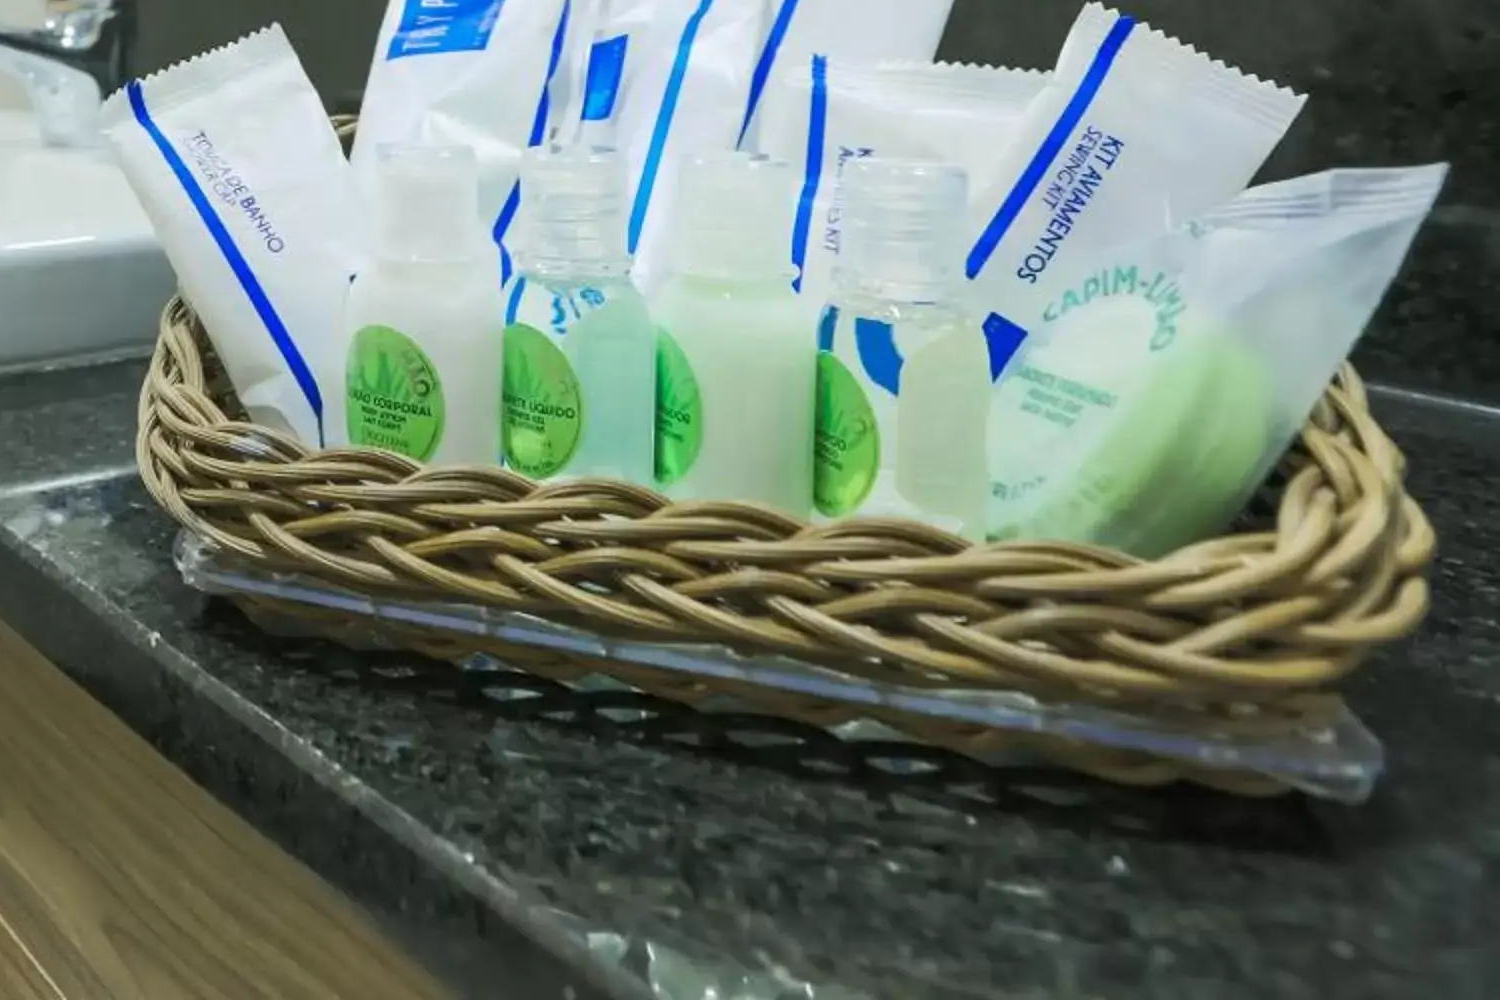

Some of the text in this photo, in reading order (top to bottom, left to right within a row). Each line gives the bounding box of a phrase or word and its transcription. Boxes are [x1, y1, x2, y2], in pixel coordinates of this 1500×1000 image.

[1017, 135, 1125, 284] KIT AVIAMENTOS
[1043, 125, 1103, 210] SEWING KIT
[240, 195, 284, 253] BANHO
